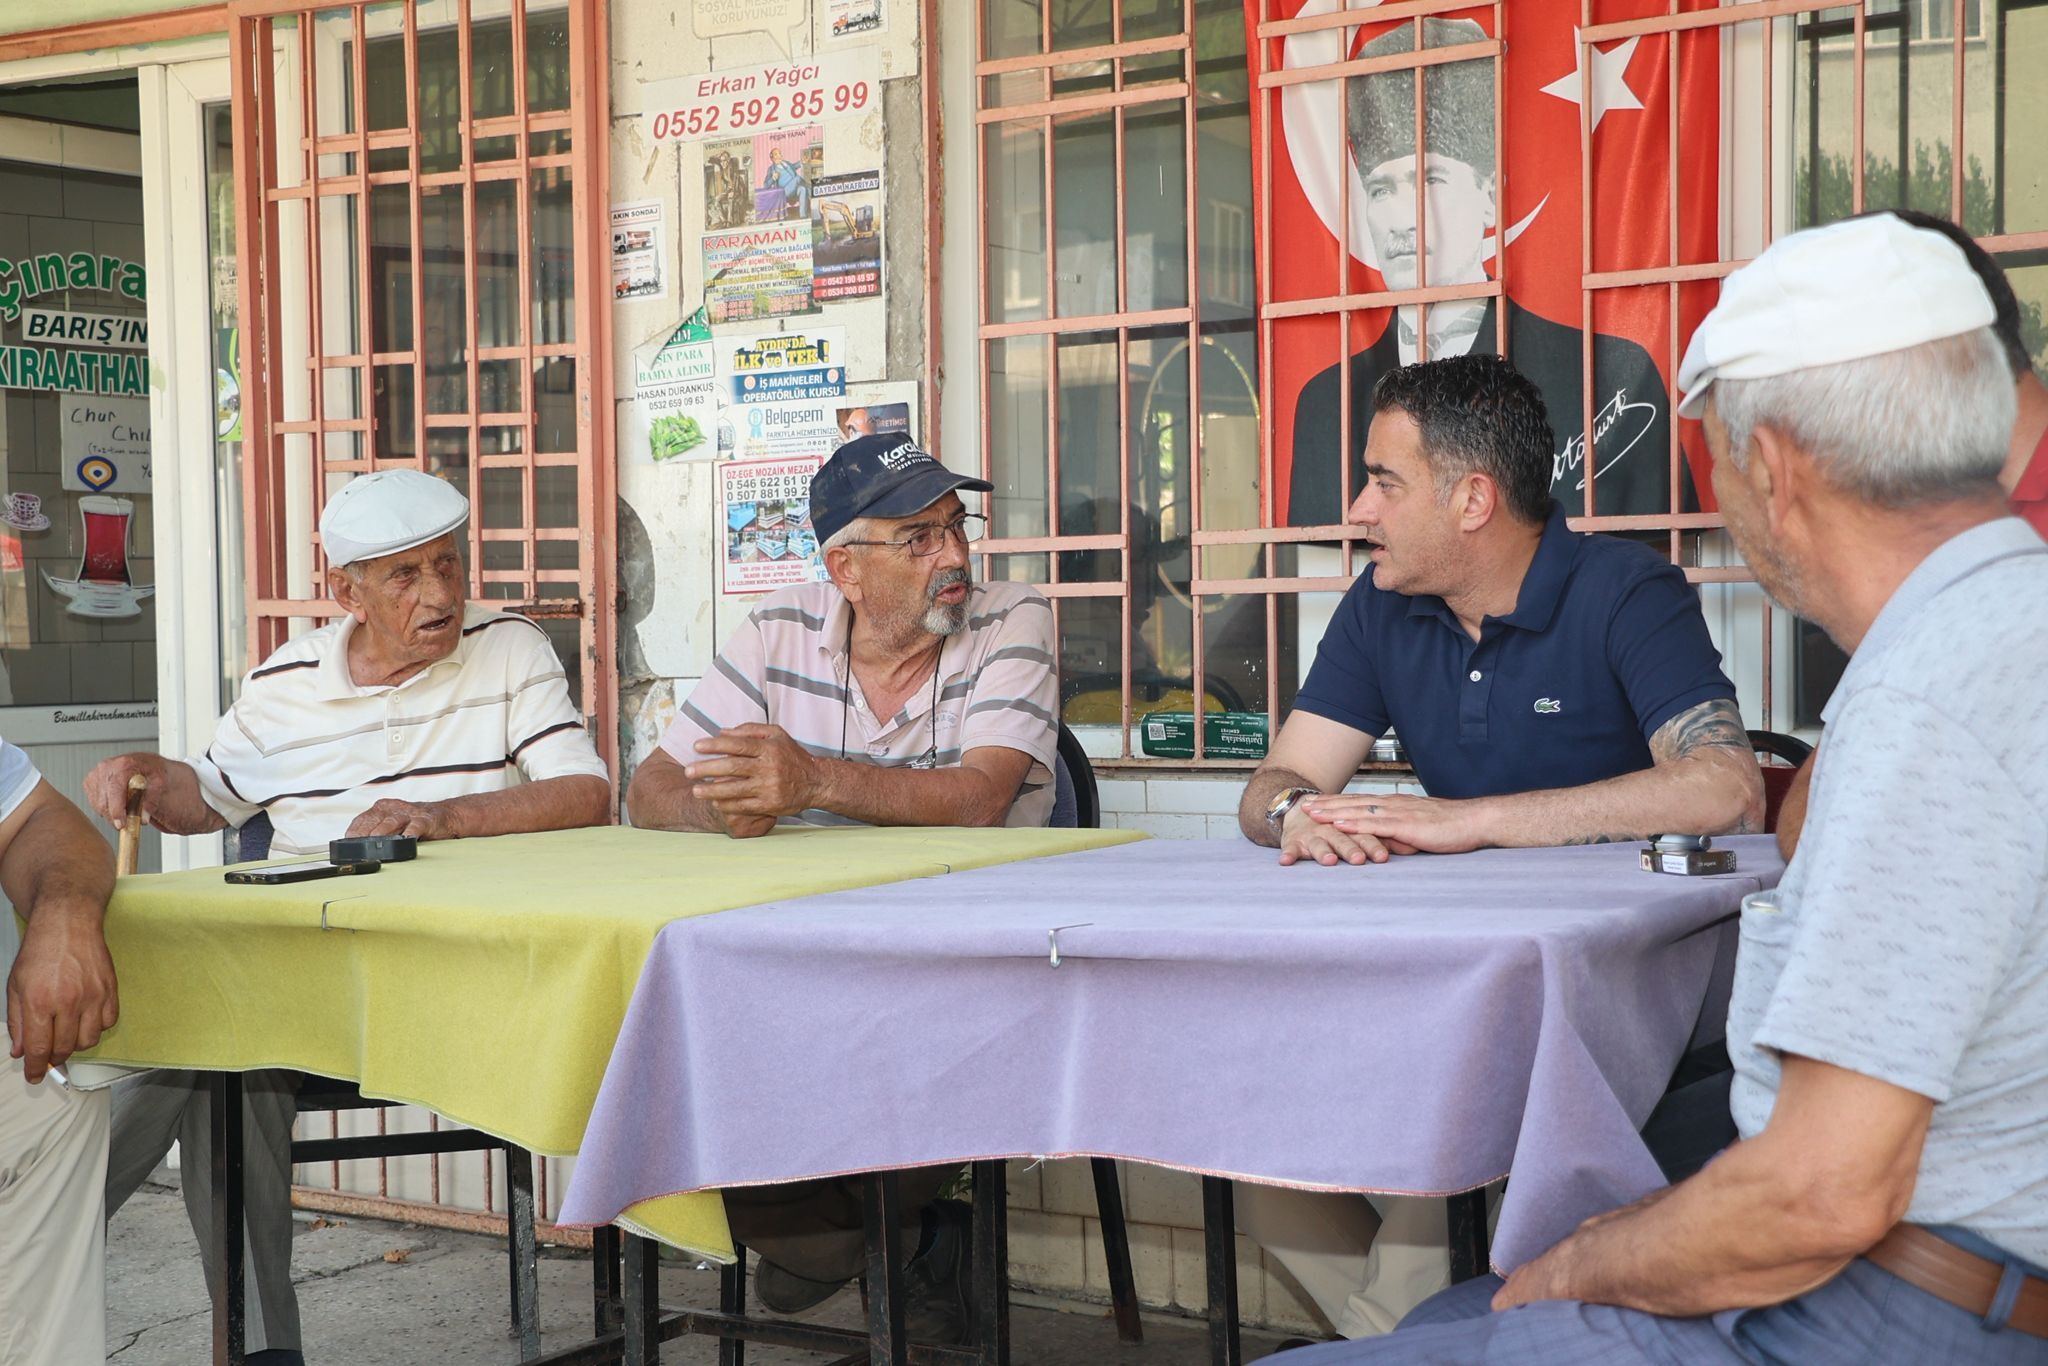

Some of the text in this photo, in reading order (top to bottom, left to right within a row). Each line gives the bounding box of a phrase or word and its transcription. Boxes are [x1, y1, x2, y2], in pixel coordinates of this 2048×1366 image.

[697, 64, 820, 98] Erkan Yağcı
[653, 82, 869, 140] 0552 592 85 99
[814, 184, 842, 196] BAYRAM
[613, 208, 658, 220] AKIN SONDAJ
[704, 229, 797, 250] KARAMAN
[755, 335, 807, 352] AYDIN'DA
[676, 349, 704, 361] PARA
[734, 348, 763, 370] İLK
[766, 352, 782, 367] ve
[786, 345, 818, 366] TEK
[676, 363, 711, 377] ALINIR
[760, 372, 823, 391] İŞ MAKİNELERİ
[637, 382, 714, 400] HASAN DURANKUŞ
[743, 386, 840, 403] OPERATÖRLÜK KURSU
[649, 396, 705, 410] 0532 659 09 63
[766, 408, 823, 428] Belgesem
[767, 429, 795, 439] FARKIYLA
[727, 465, 814, 480] ÖZ-EGE MOZAİK MEZAR
[727, 481, 733, 490] 0
[737, 479, 757, 490] 546
[760, 477, 780, 487] 622
[784, 475, 797, 486] 61
[727, 487, 810, 501] 0 507 881 99 2
